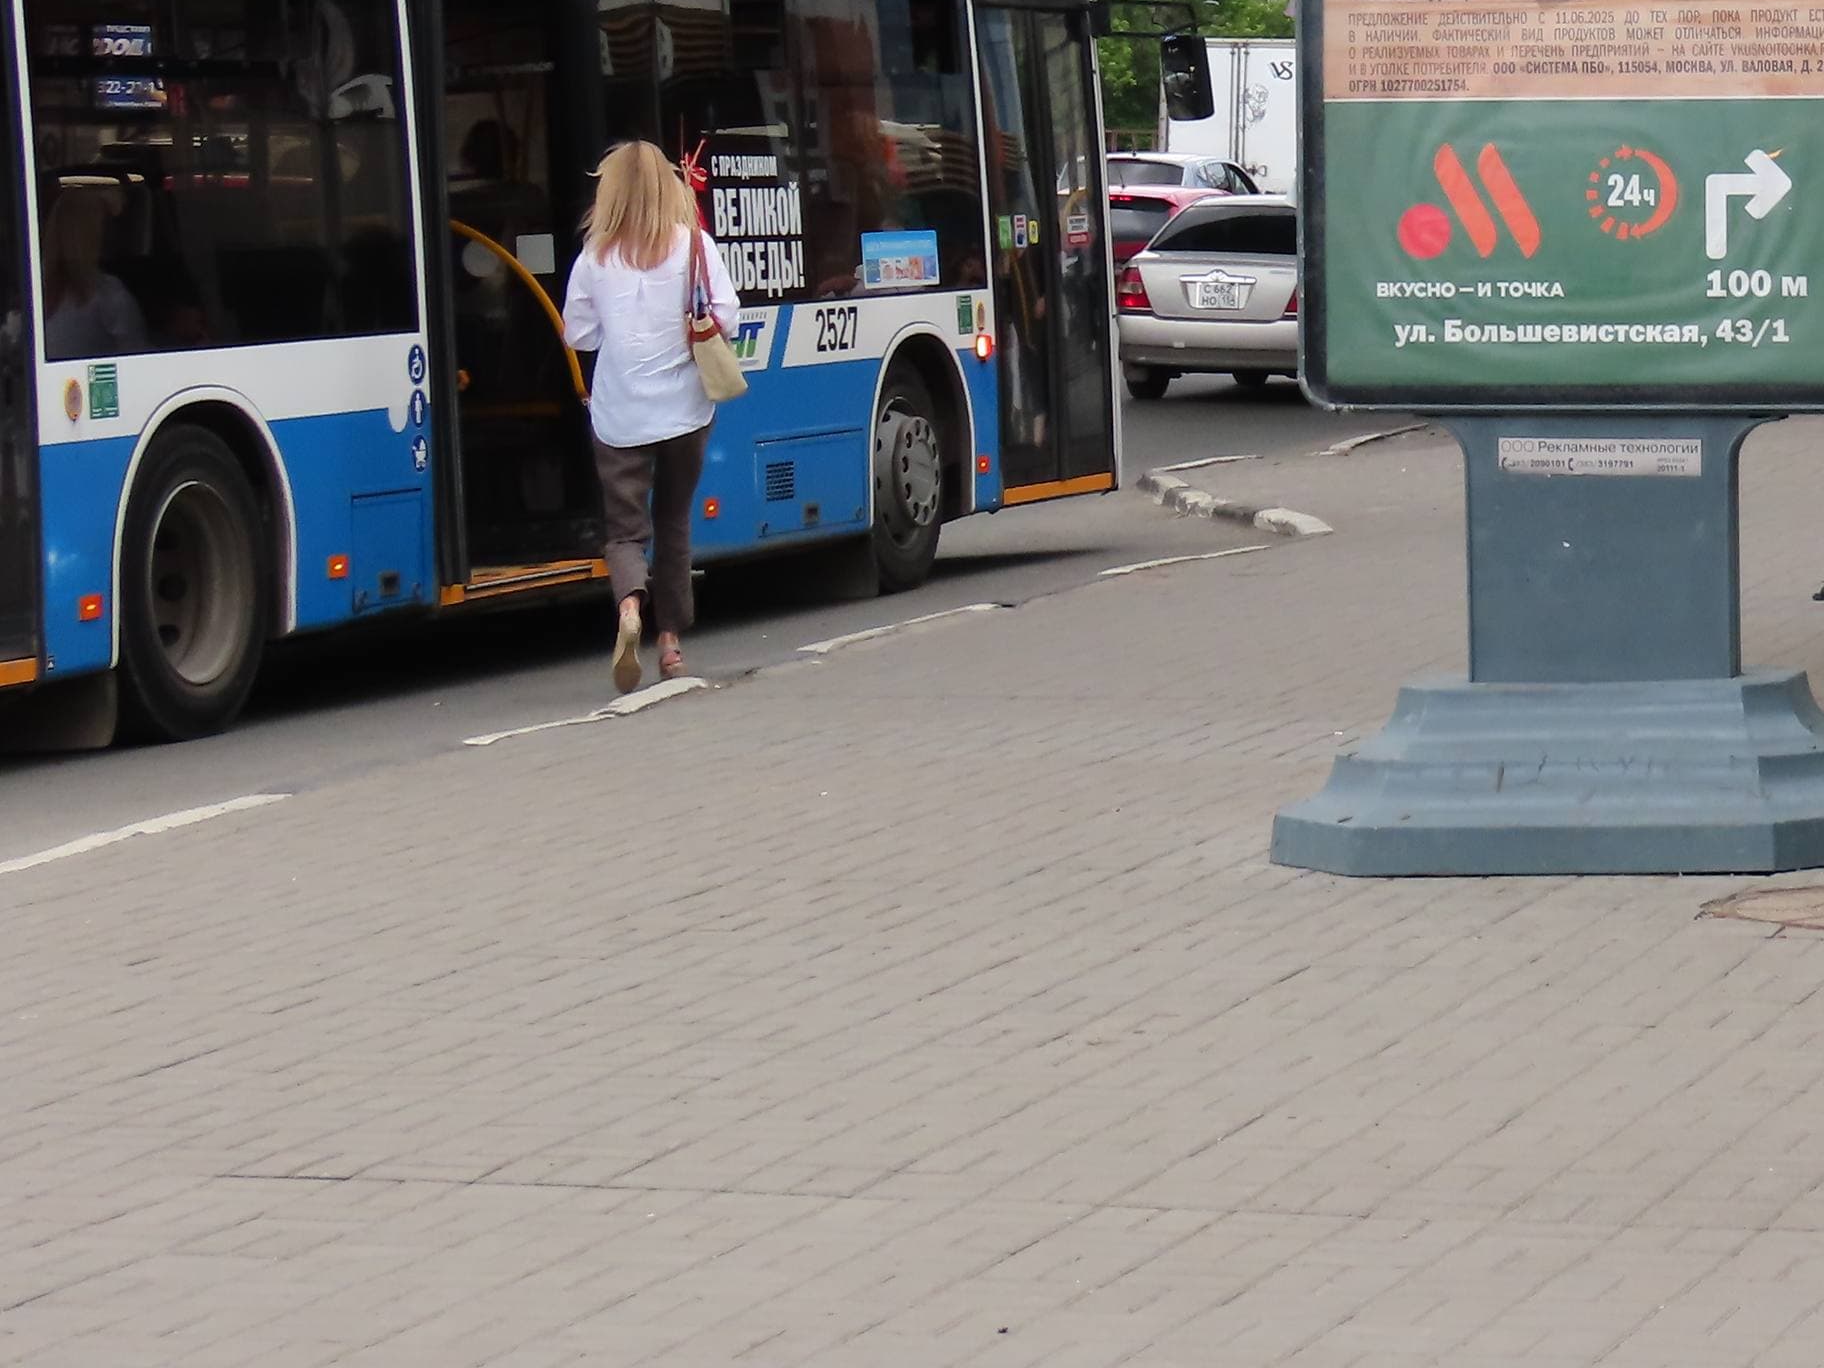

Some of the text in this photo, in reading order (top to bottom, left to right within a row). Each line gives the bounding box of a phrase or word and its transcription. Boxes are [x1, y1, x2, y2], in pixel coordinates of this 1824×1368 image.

[1349, 12, 1428, 26] ПРЕДЛОЖЕНИЕ
[1438, 11, 1528, 26] ДЕЙСТВИТЕЛЬНО
[1556, 11, 1614, 24] 11.06.2025
[1624, 10, 1640, 25] ДО
[1650, 10, 1667, 23] ТЕХ
[1712, 10, 1741, 22] ПОКА
[1750, 9, 1798, 23] ПРОДУКТ
[1432, 26, 1510, 42] ФАКТИЧЕСКИЙ
[1554, 27, 1616, 42] ПРОДУКТОВ
[1627, 27, 1664, 40] МОЖЕТ
[1362, 46, 1440, 59] РЕАЛИЗУЕМЫХ
[1446, 45, 1490, 59] ТОВАРАХ
[1512, 44, 1564, 57] ПЕРЕЧЕНЬ
[1572, 42, 1650, 58] ПРЕДПРИЯТИЙ
[1672, 43, 1686, 56] НА
[1692, 41, 1724, 56] САЙТЕ
[1370, 62, 1409, 76] УГОЛКЕ
[1493, 62, 1516, 74] ООО
[1520, 61, 1578, 74] «СИСТЕМА
[1618, 61, 1662, 75] 115054,
[1666, 60, 1716, 74] МОСКВА,
[1720, 60, 1737, 73] УЛ.
[1742, 60, 1797, 74] ВАЛОВАЯ,
[1801, 61, 1813, 75] Д.
[1349, 80, 1376, 92] ОГРН
[711, 155, 778, 180] С ПРАЗДНИКОМ
[1608, 173, 1655, 207] 24ч
[713, 182, 802, 237] ВЕЛИКОЙ
[1376, 282, 1456, 298] ВКУСНО
[1478, 282, 1492, 298] И
[1496, 282, 1565, 298] ТОЧКА
[1706, 270, 1808, 298] 100 м
[816, 306, 858, 352] 2527
[1393, 319, 1790, 348] ул. Большевистская, 43/1
[1501, 440, 1699, 454] ООО Рекламные технологии
